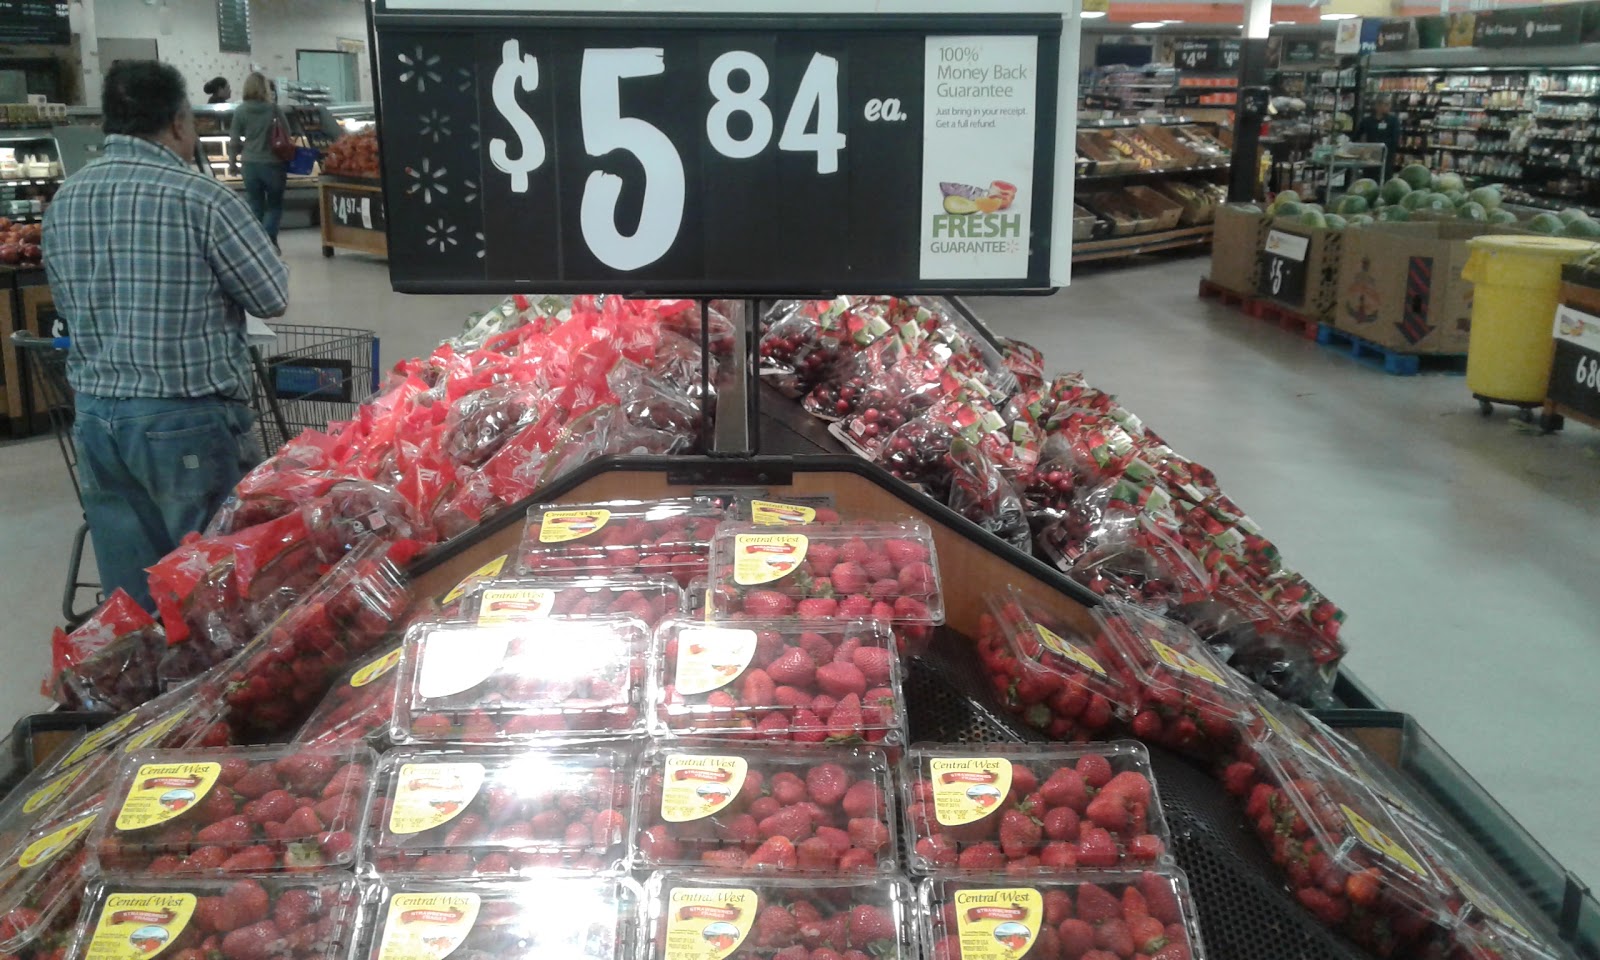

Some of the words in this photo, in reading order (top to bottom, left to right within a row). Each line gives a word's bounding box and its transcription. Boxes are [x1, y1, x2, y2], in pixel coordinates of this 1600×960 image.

[939, 46, 979, 62] 100%
[937, 65, 989, 83] Money
[993, 64, 1028, 80] Back
[936, 82, 1014, 98] Guarantee
[864, 97, 907, 122] ea.
[936, 107, 950, 116] Just
[951, 107, 972, 118] bring
[973, 107, 980, 116] in
[981, 108, 998, 117] your
[936, 120, 950, 128] Get
[957, 119, 969, 128] full
[932, 213, 1021, 238] FRESH
[930, 241, 1006, 253] GUARANTEE
[739, 535, 773, 543] Central
[776, 535, 799, 543] West
[668, 757, 707, 767] Central
[709, 757, 736, 768] West
[933, 759, 973, 770] Central
[974, 759, 1000, 769] West
[140, 764, 181, 776] Central
[182, 763, 210, 774] West
[108, 895, 153, 908] Central
[154, 895, 185, 906] West
[394, 896, 439, 907] Central
[440, 895, 470, 906] West
[718, 891, 746, 903] West
[957, 891, 1000, 904] Central
[1001, 891, 1030, 902] West
